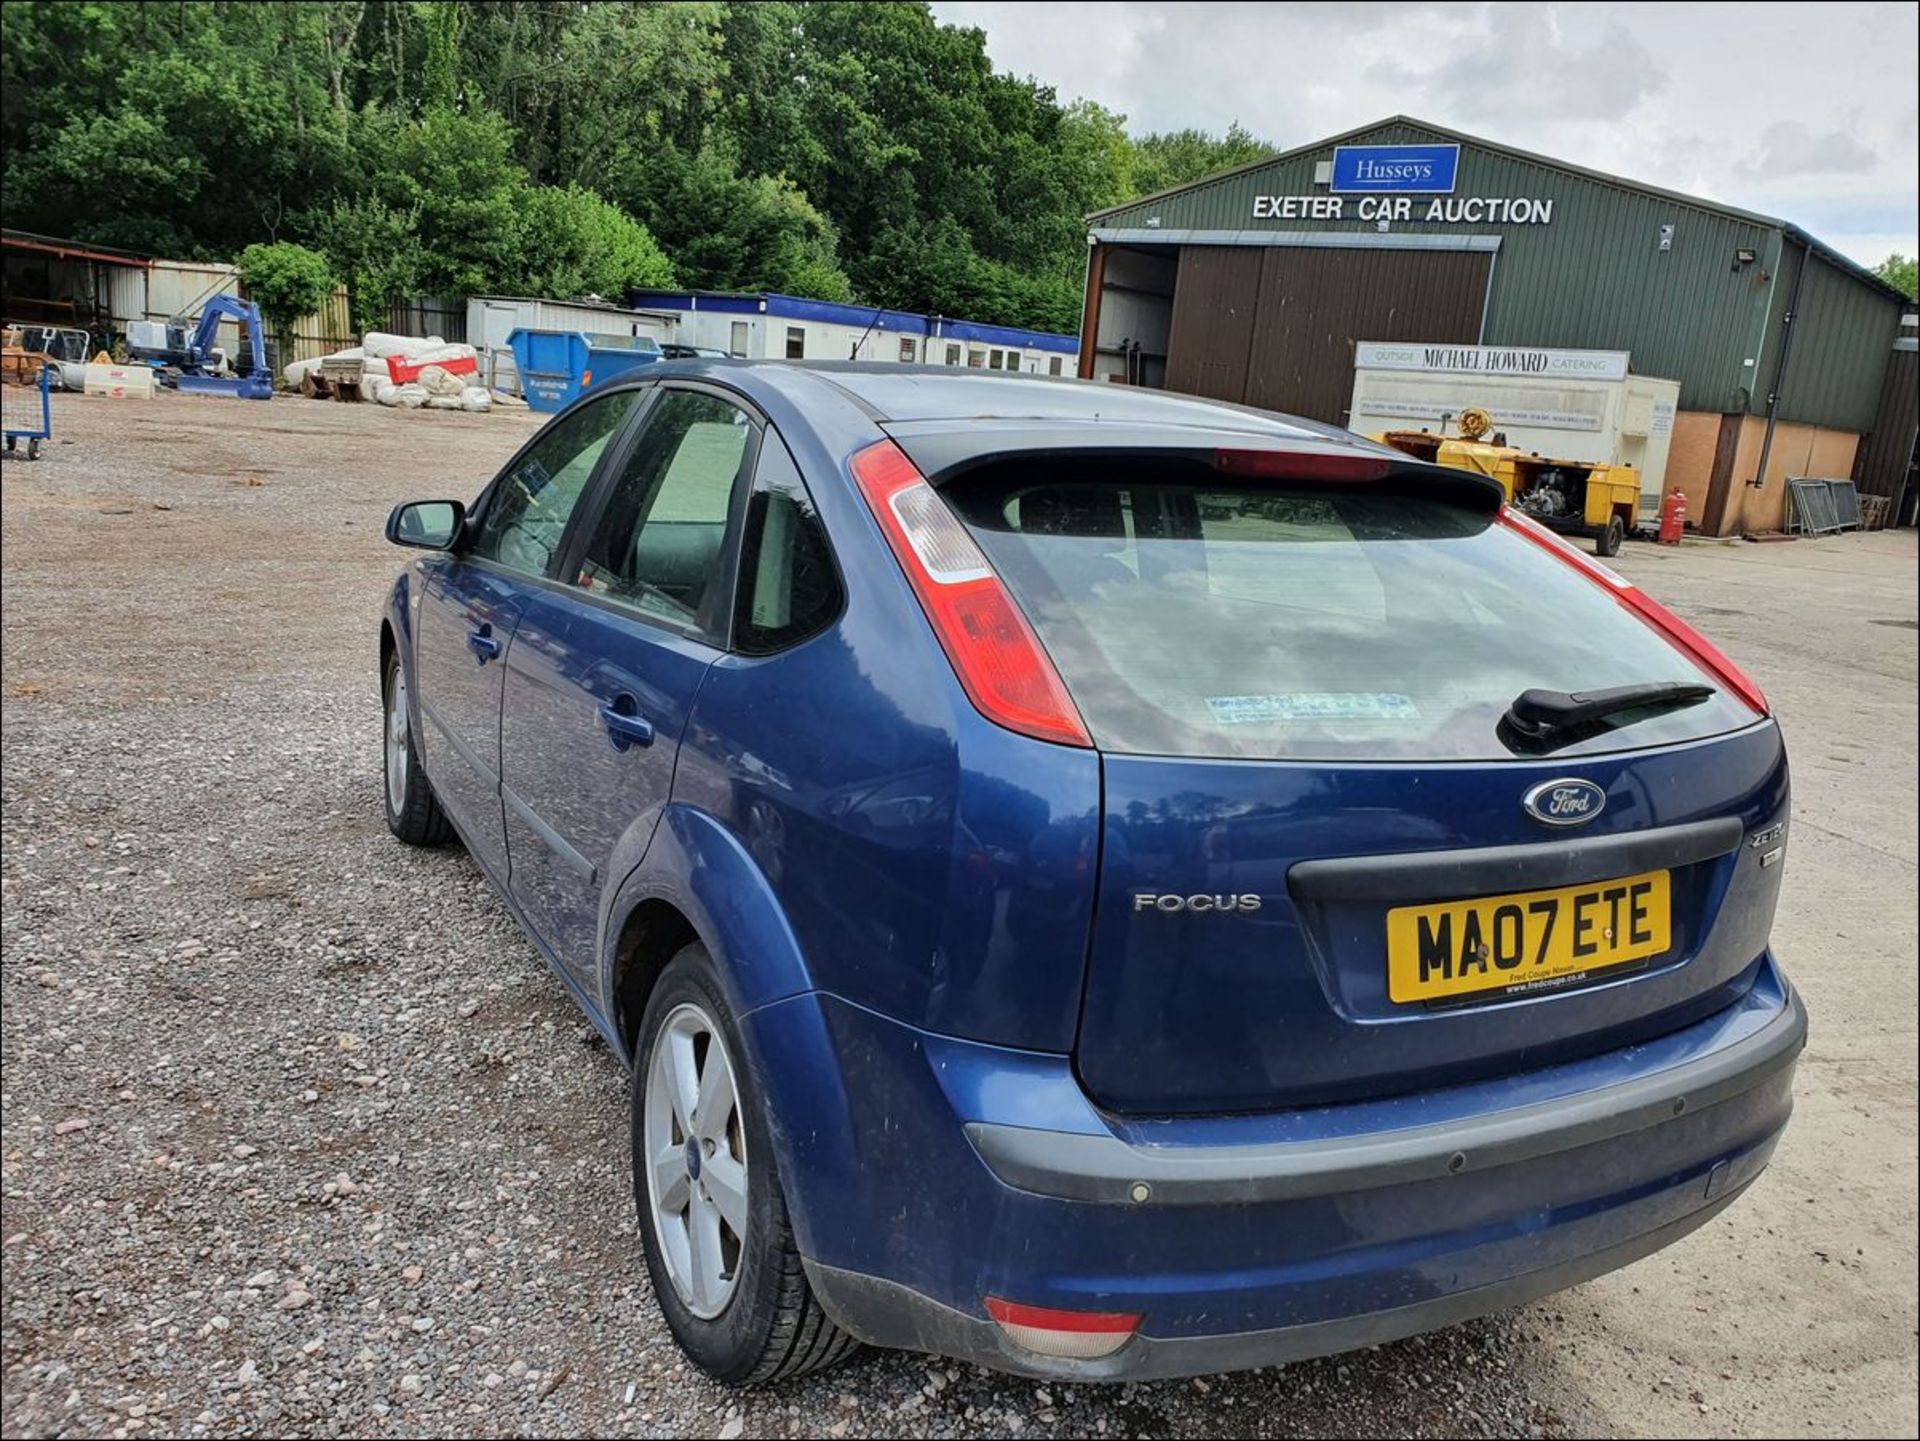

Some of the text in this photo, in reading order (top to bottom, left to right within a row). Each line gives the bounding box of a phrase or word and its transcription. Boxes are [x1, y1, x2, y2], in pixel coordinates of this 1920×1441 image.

[1356, 160, 1432, 181] Husseys
[1253, 195, 1552, 224] EXETER CAR AUCTION
[1376, 348, 1608, 372] OUTSIDE MICHAEL HOWARD CATERING
[1549, 788, 1589, 814] Ford
[1133, 894, 1262, 912] FOCUS
[1417, 881, 1652, 983] MA07 ETE
